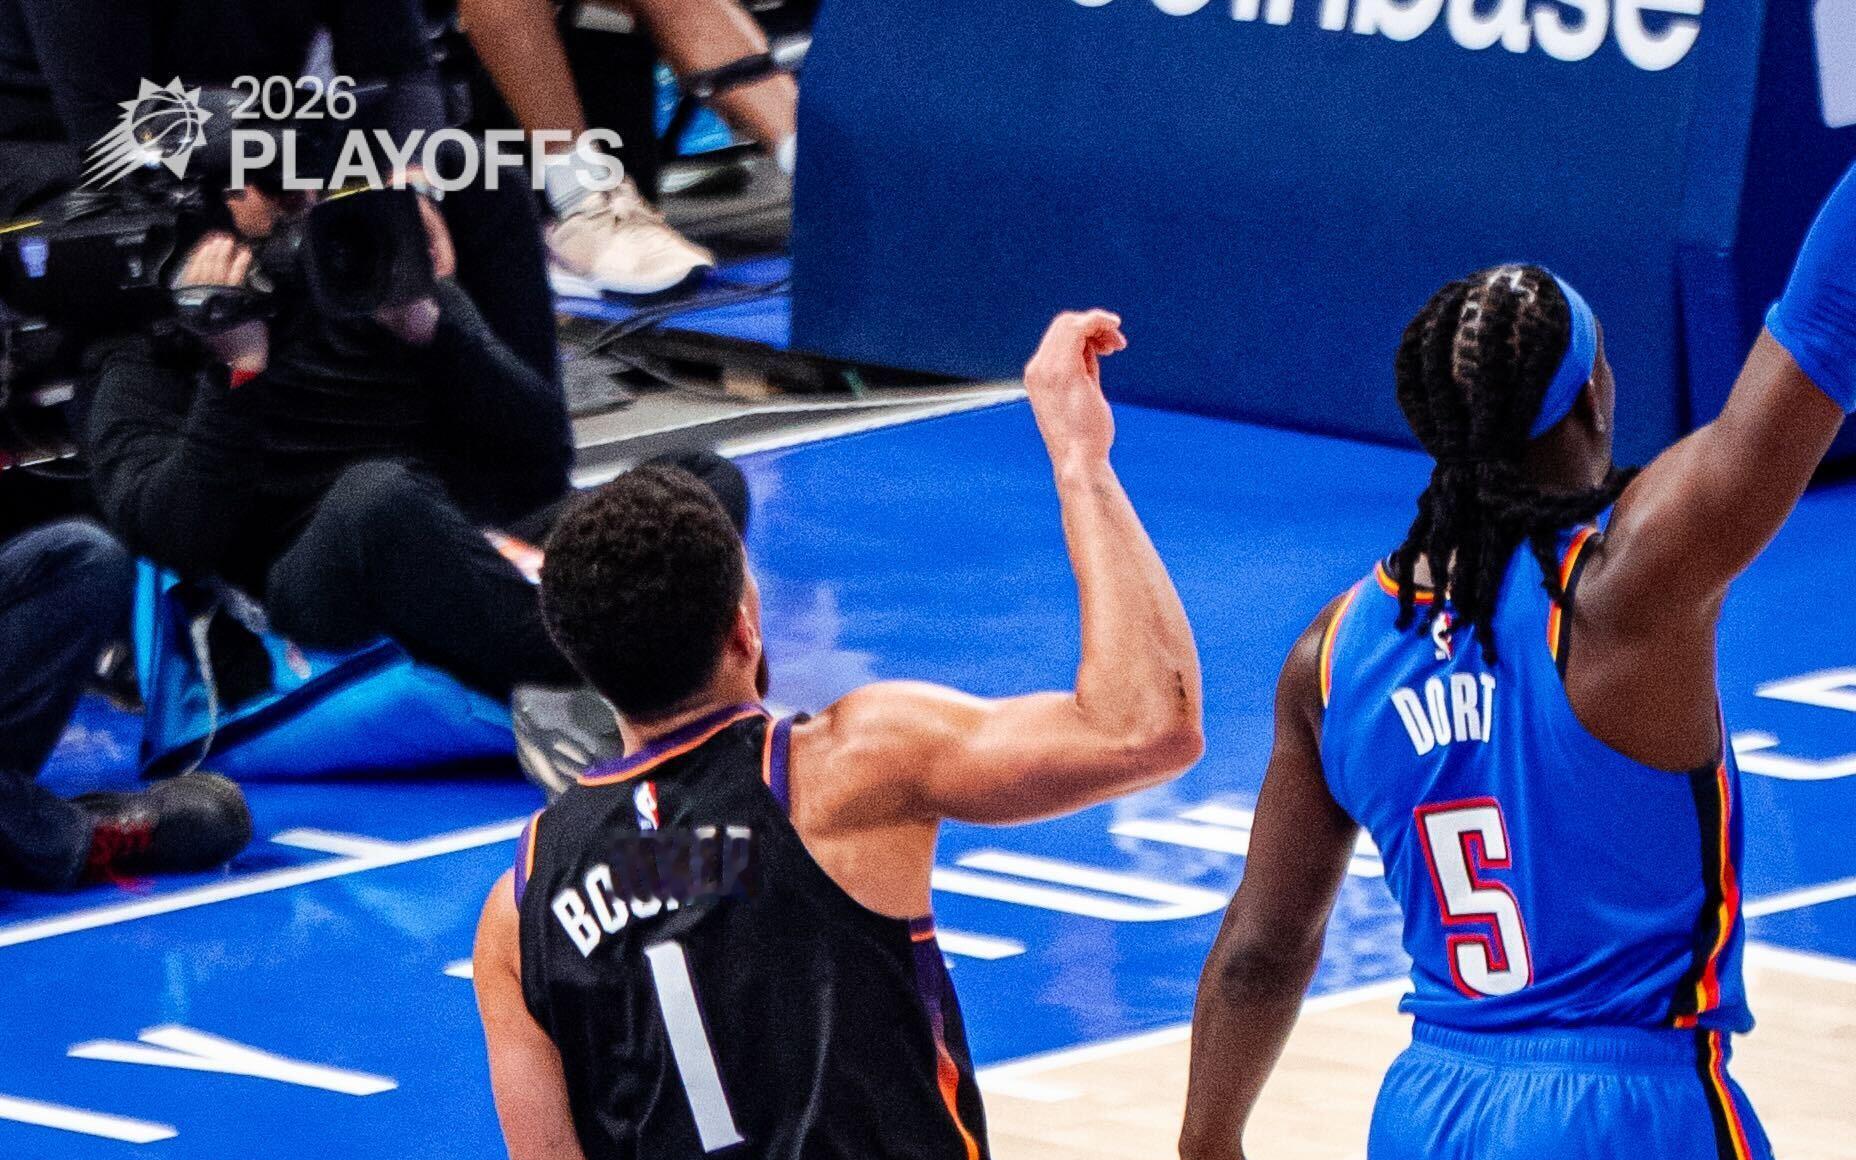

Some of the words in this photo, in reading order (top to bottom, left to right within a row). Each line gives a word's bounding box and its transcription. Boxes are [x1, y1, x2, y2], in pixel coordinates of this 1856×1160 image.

[1392, 672, 1496, 756] DORT
[1414, 797, 1534, 999] 5
[644, 941, 745, 1152] 1
